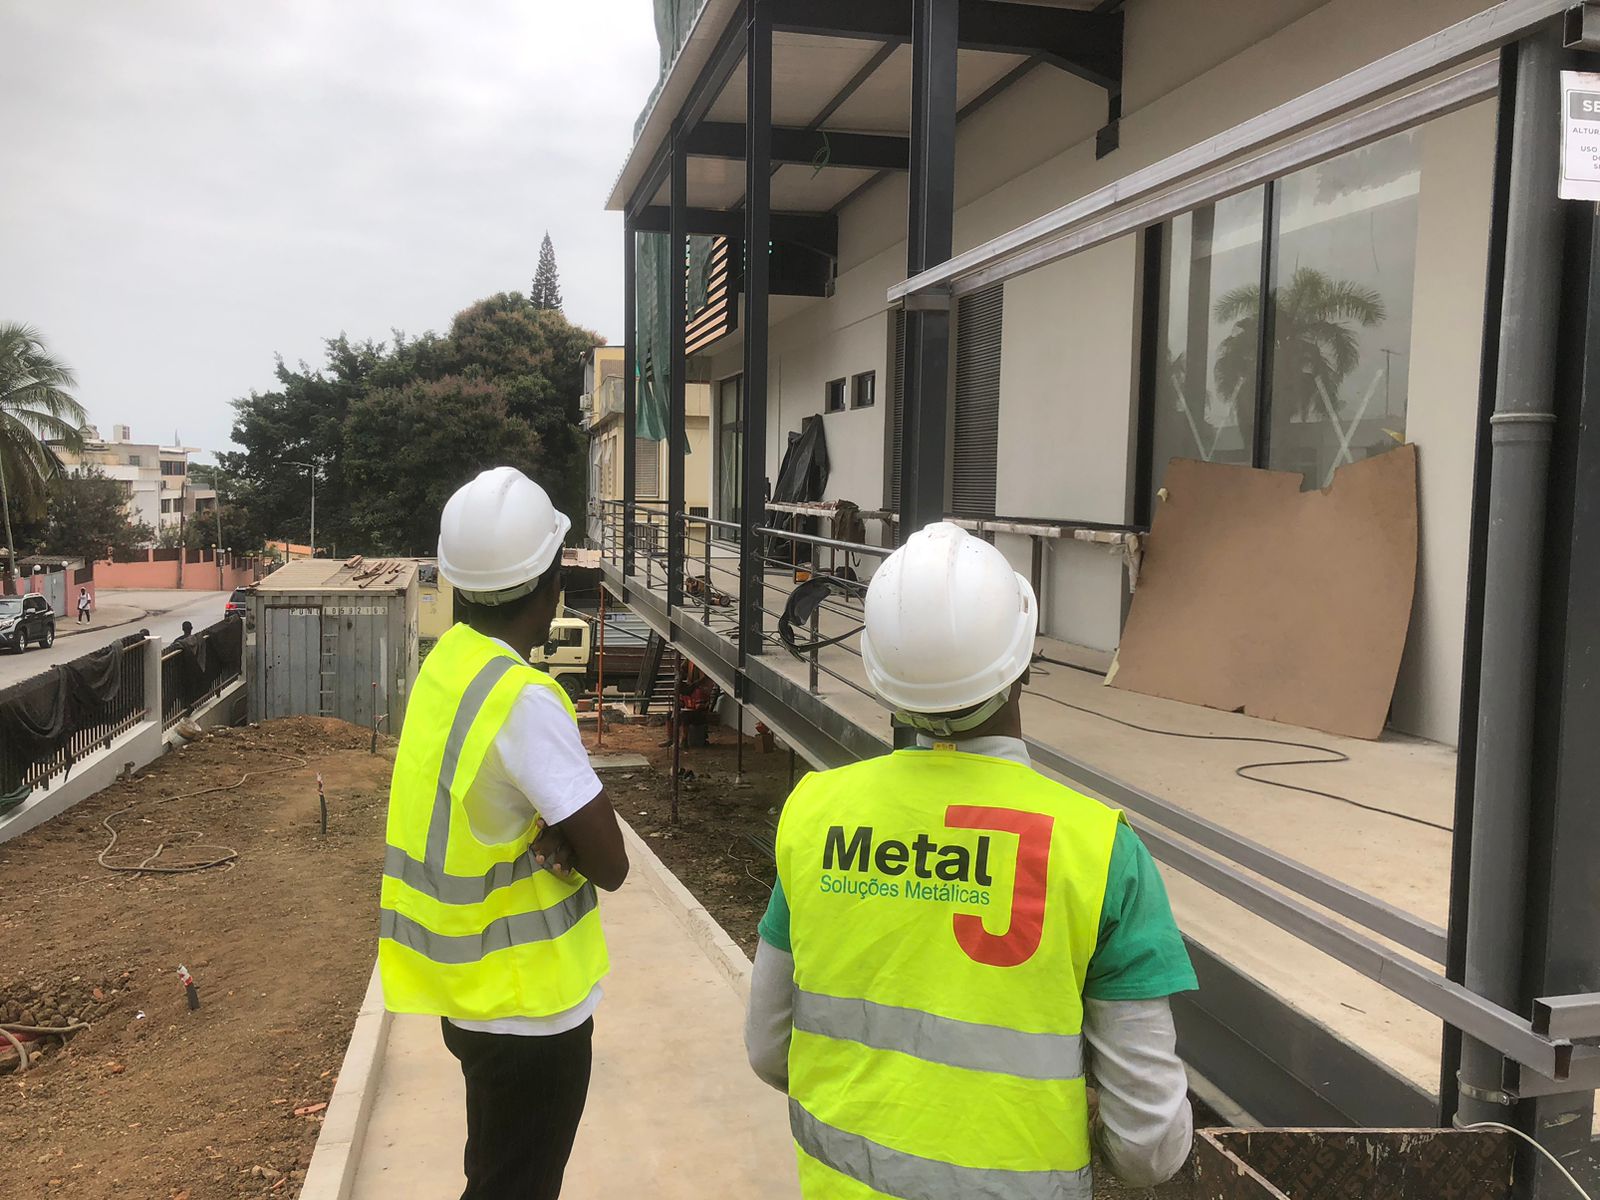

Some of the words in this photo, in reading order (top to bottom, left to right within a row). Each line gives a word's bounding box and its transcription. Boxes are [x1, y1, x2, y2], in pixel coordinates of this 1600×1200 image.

[1572, 127, 1600, 136] ALTUR
[1580, 145, 1598, 153] USO
[822, 826, 992, 887] Metal
[820, 874, 899, 900] Soluções
[905, 880, 990, 905] Metálicas
[944, 805, 1055, 968] J
